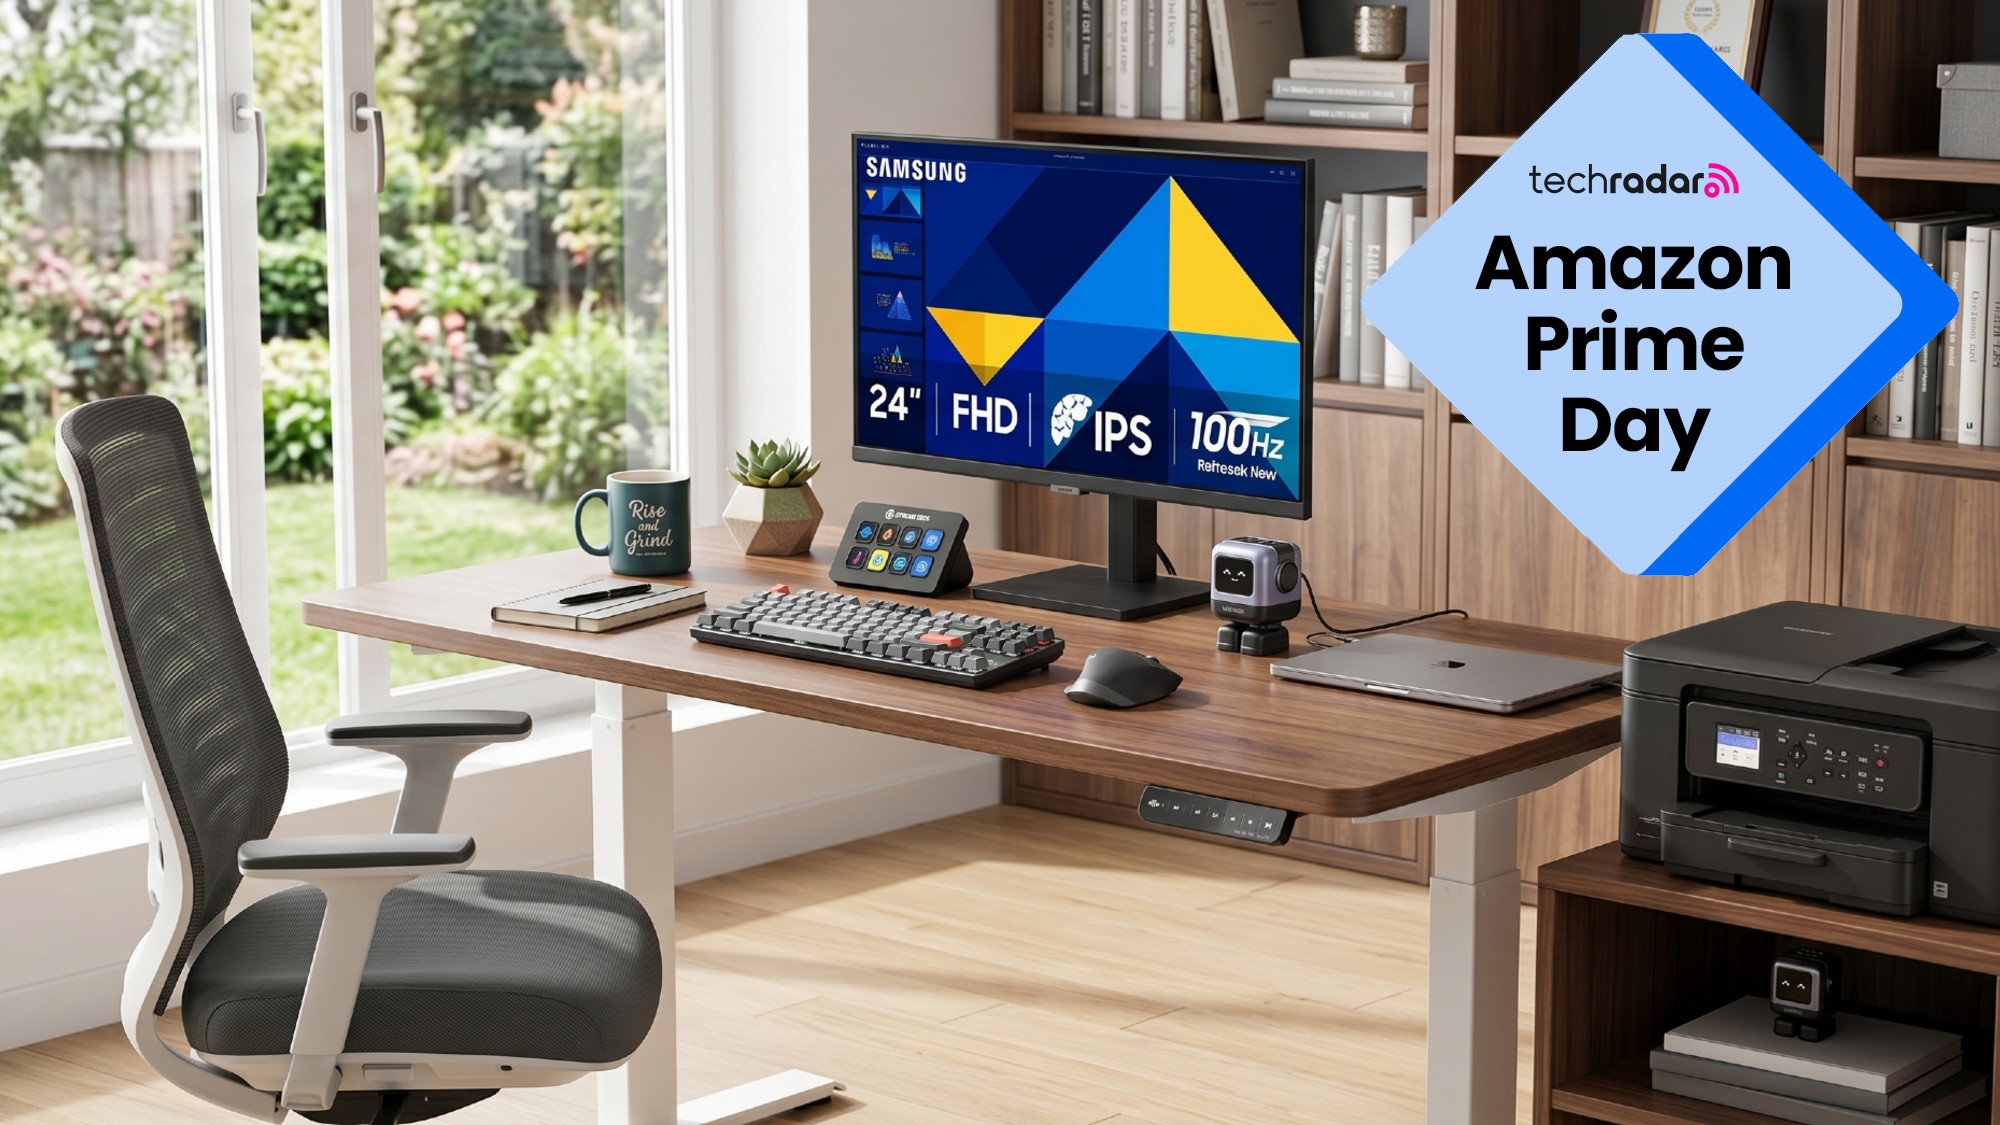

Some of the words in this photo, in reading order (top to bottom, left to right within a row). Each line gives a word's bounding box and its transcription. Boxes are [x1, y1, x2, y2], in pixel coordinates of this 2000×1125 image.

[866, 156, 966, 183] SAMSUNG
[869, 383, 922, 421] 24"
[953, 392, 1018, 435] FHD
[1095, 411, 1153, 457] IPS
[1250, 465, 1277, 481] New
[628, 499, 667, 520] Rise
[638, 519, 660, 531] and
[624, 529, 673, 555] Grind
